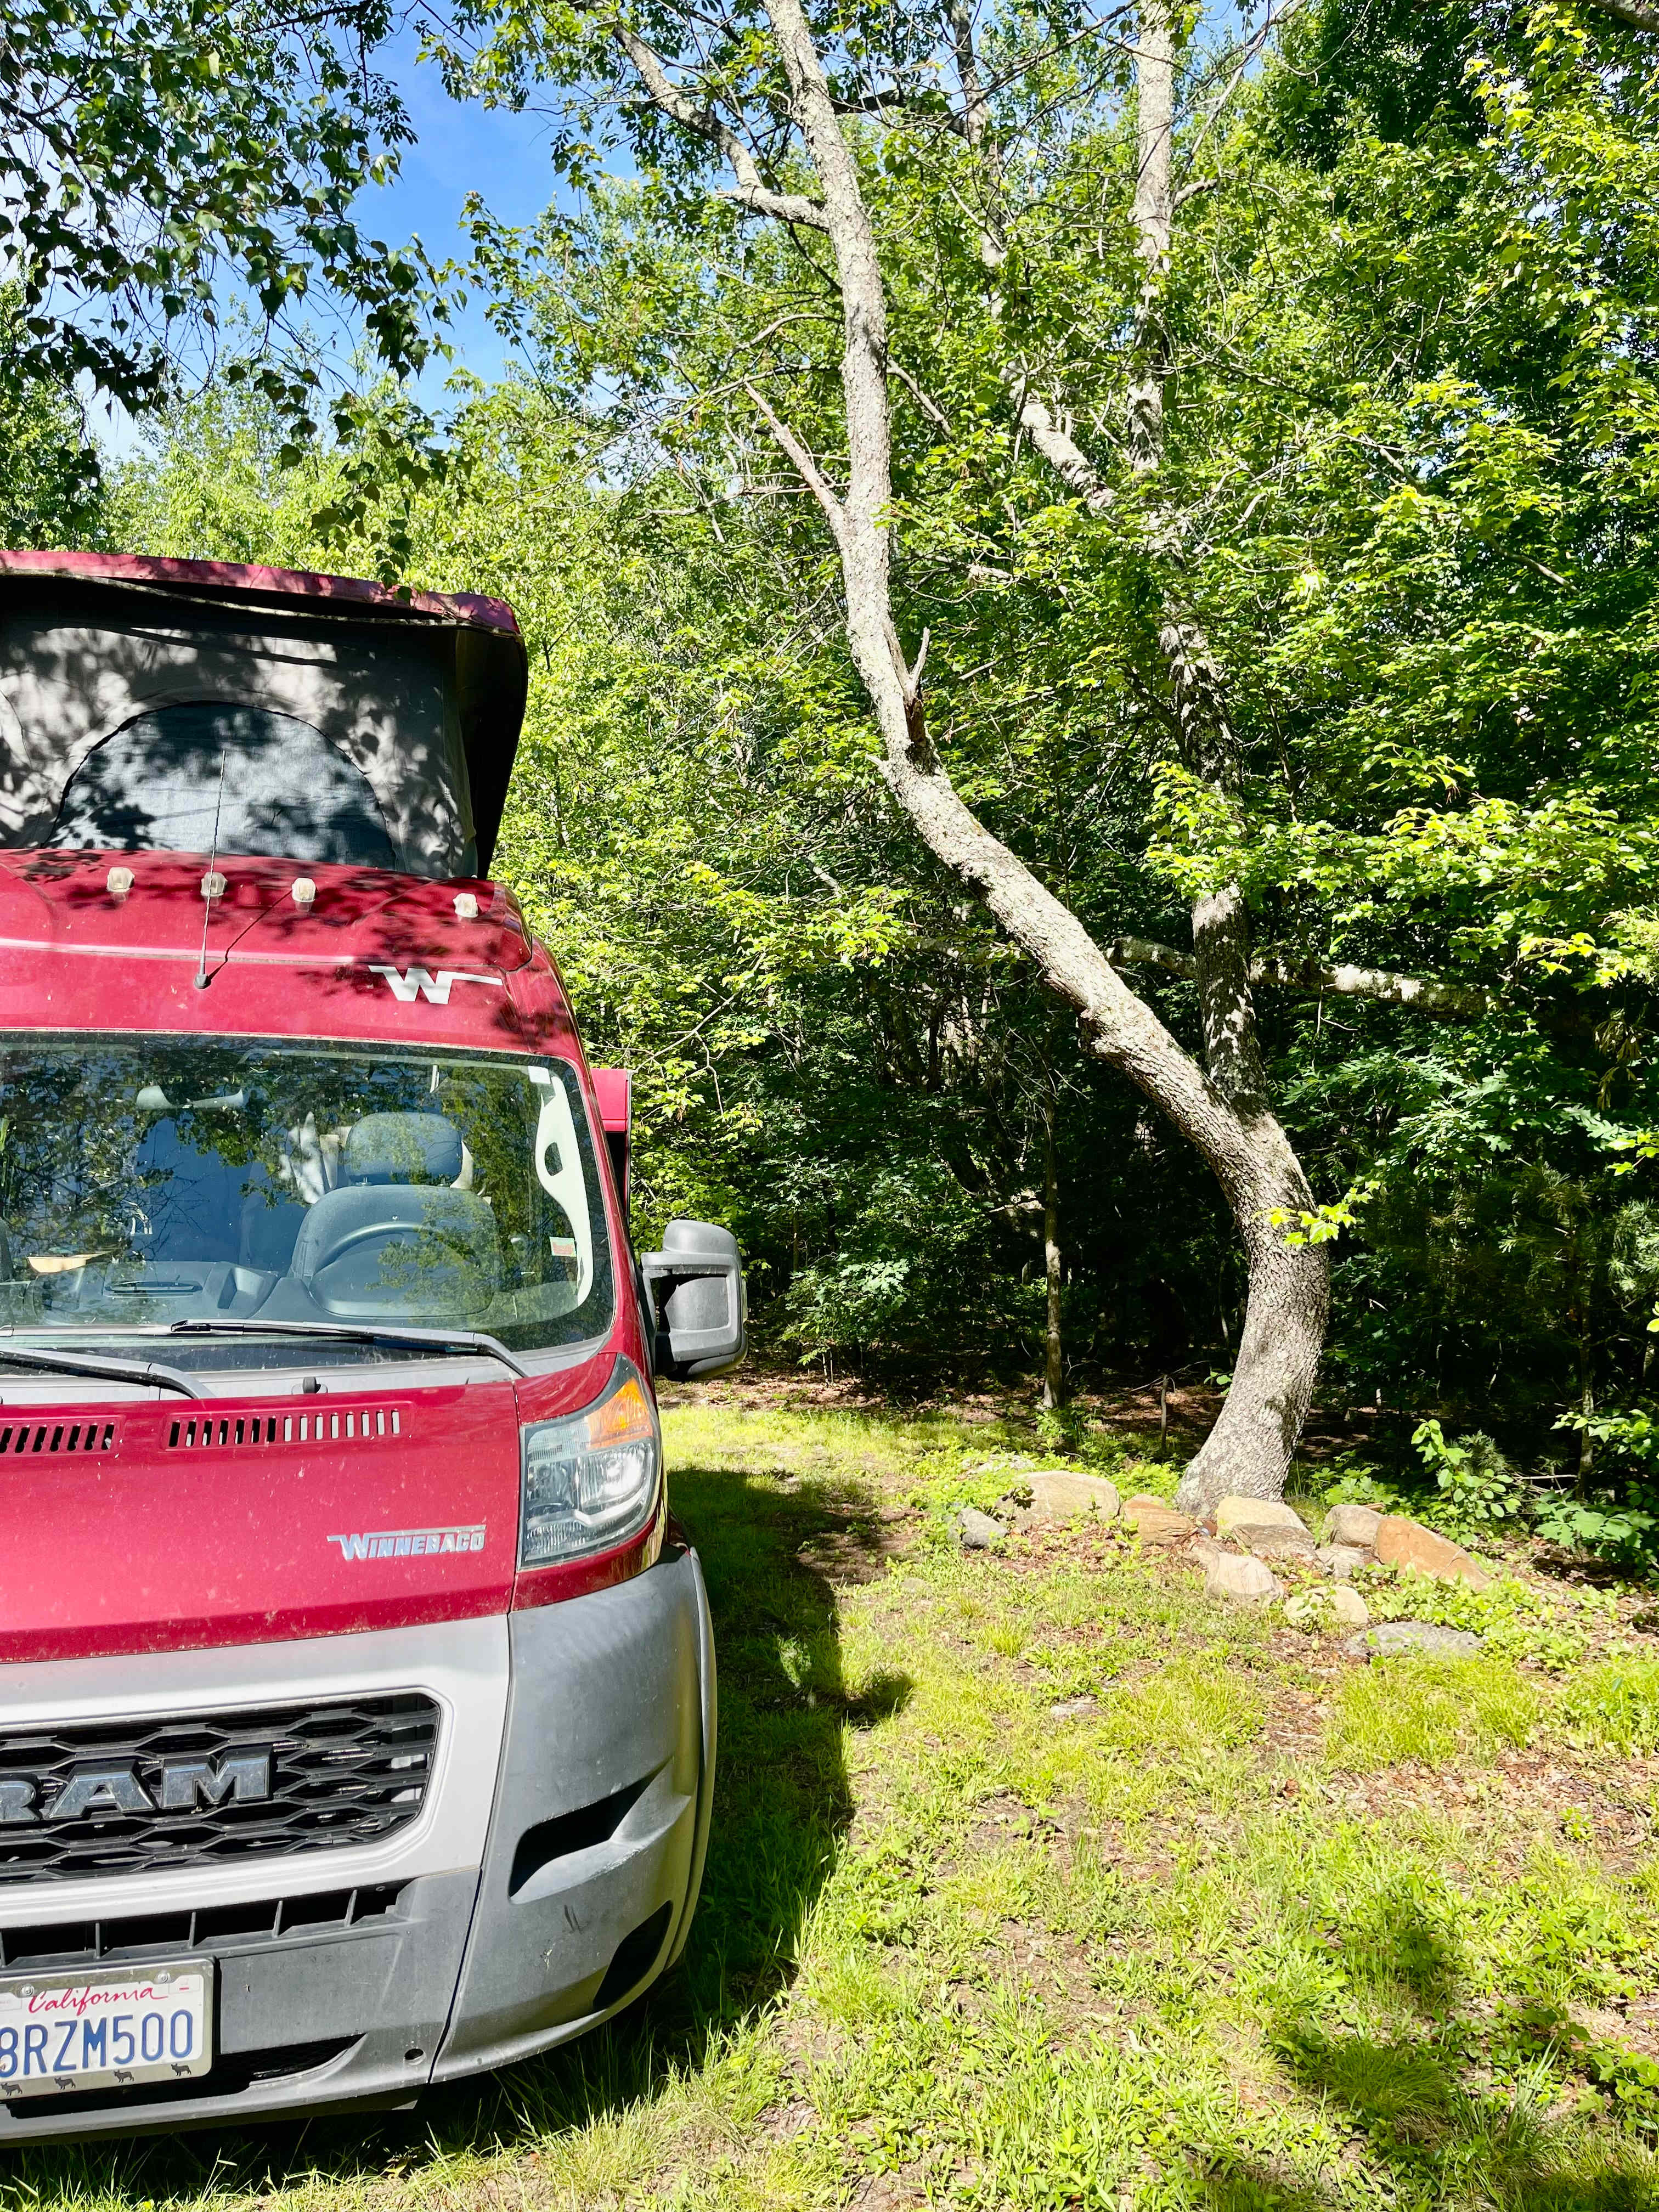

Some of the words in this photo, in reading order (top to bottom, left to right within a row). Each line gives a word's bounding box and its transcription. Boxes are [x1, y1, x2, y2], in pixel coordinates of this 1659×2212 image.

[327, 1524, 486, 1561] WINNEBAGO
[29, 1986, 168, 2016] California
[0, 2009, 193, 2078] 8RZM500
